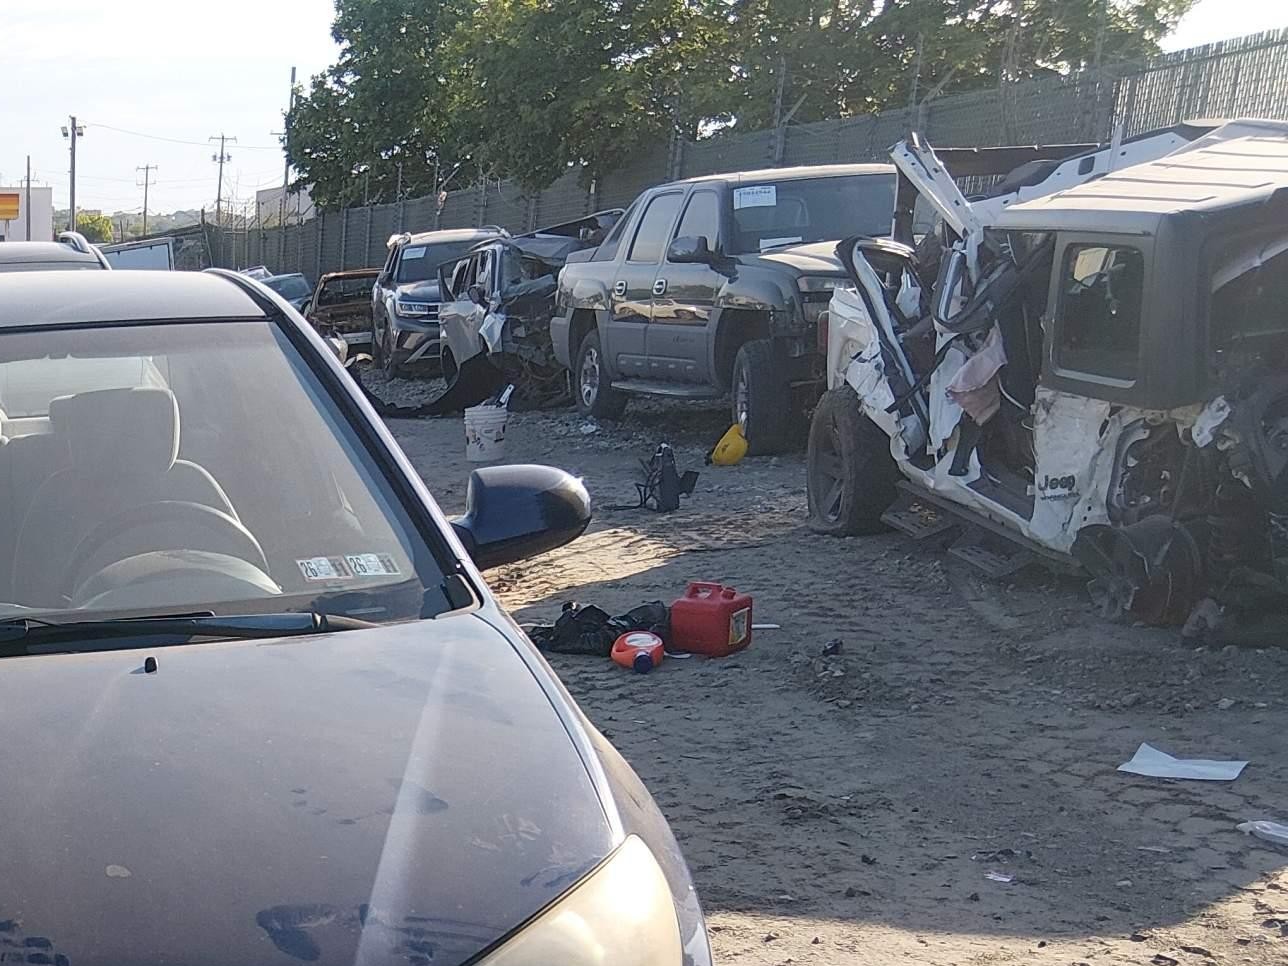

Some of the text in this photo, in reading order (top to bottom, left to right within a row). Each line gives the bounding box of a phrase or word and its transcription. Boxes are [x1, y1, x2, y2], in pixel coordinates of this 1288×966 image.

[1038, 474, 1076, 492] Jeep
[300, 561, 318, 578] 26
[349, 557, 368, 574] 26
